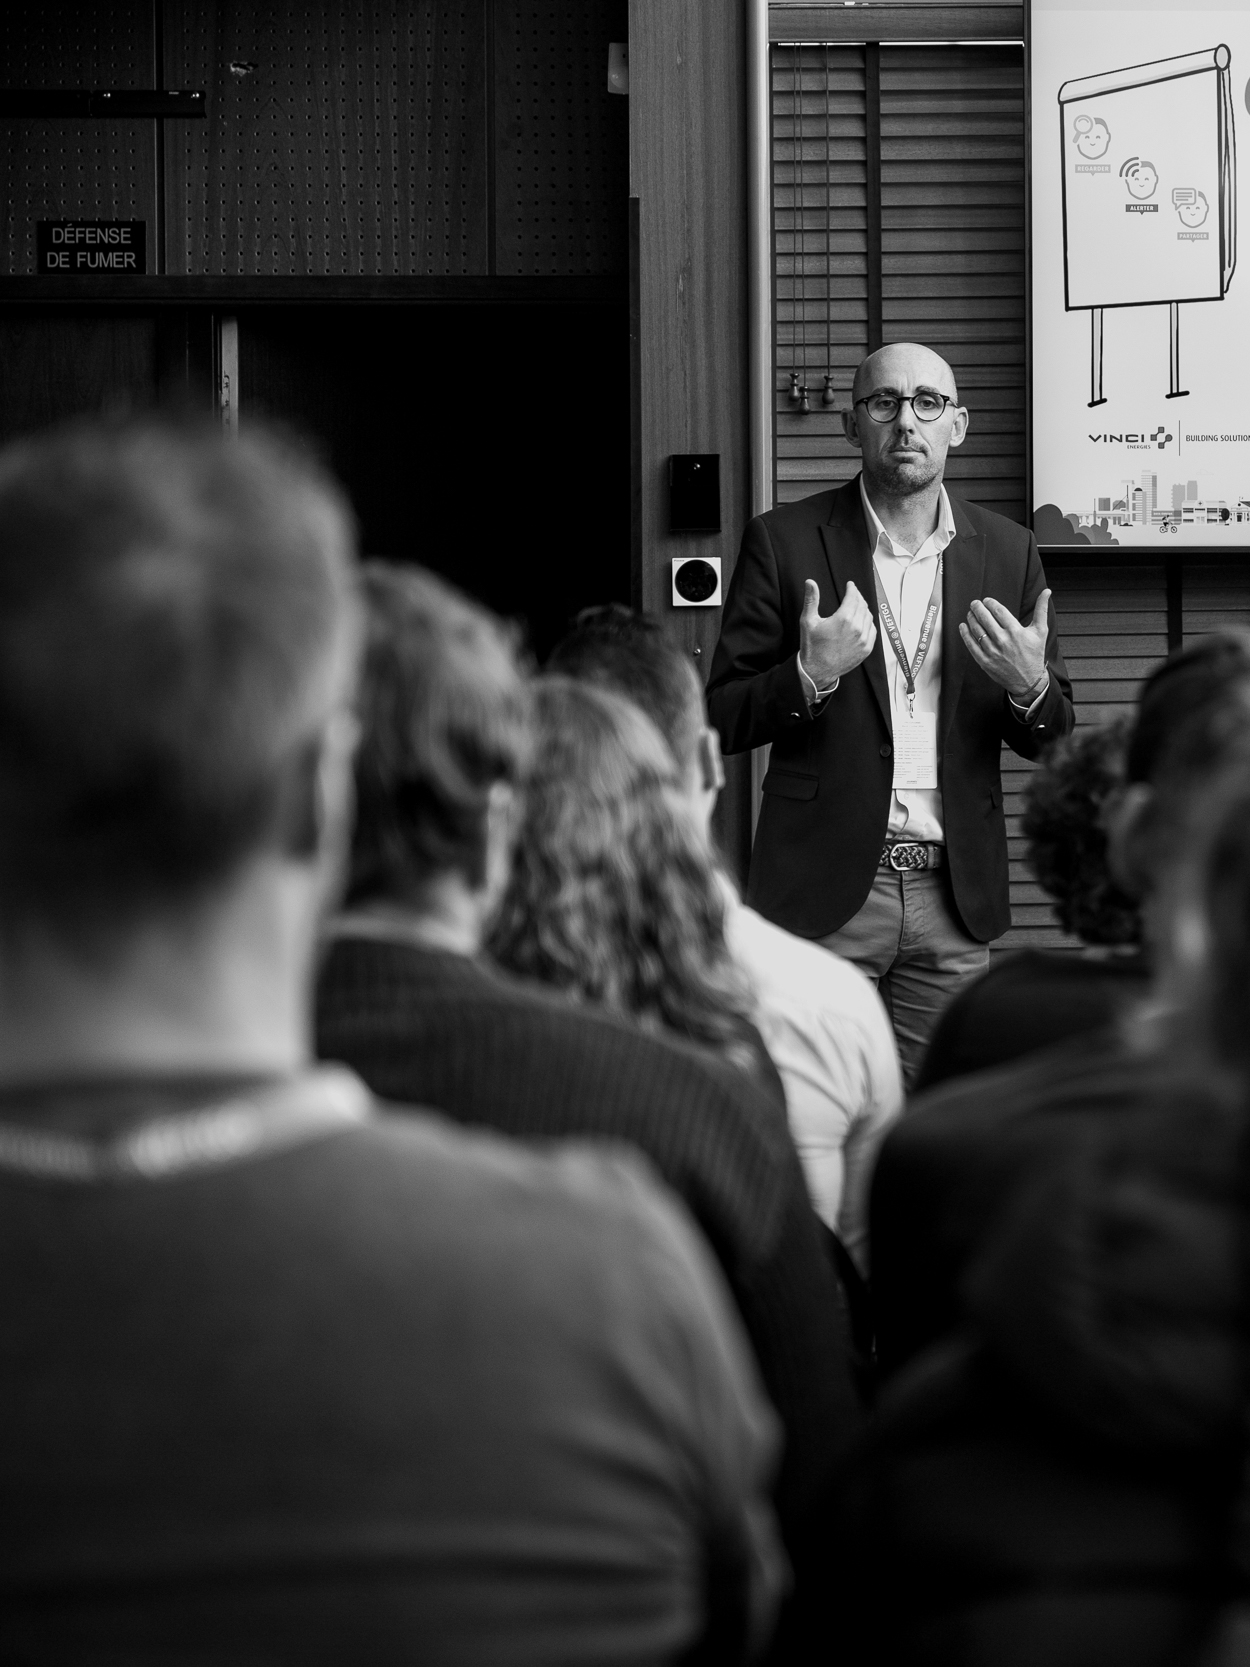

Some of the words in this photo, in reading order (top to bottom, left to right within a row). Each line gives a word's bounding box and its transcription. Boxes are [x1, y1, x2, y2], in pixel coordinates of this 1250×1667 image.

[52, 223, 132, 244] DÉFENSE
[46, 252, 70, 268] DE
[77, 252, 137, 268] FUMER
[1088, 434, 1145, 443] VINCI
[1185, 434, 1219, 442] BUILDING
[922, 605, 937, 643] Bienvenue
[894, 639, 911, 677] Bienvenue
